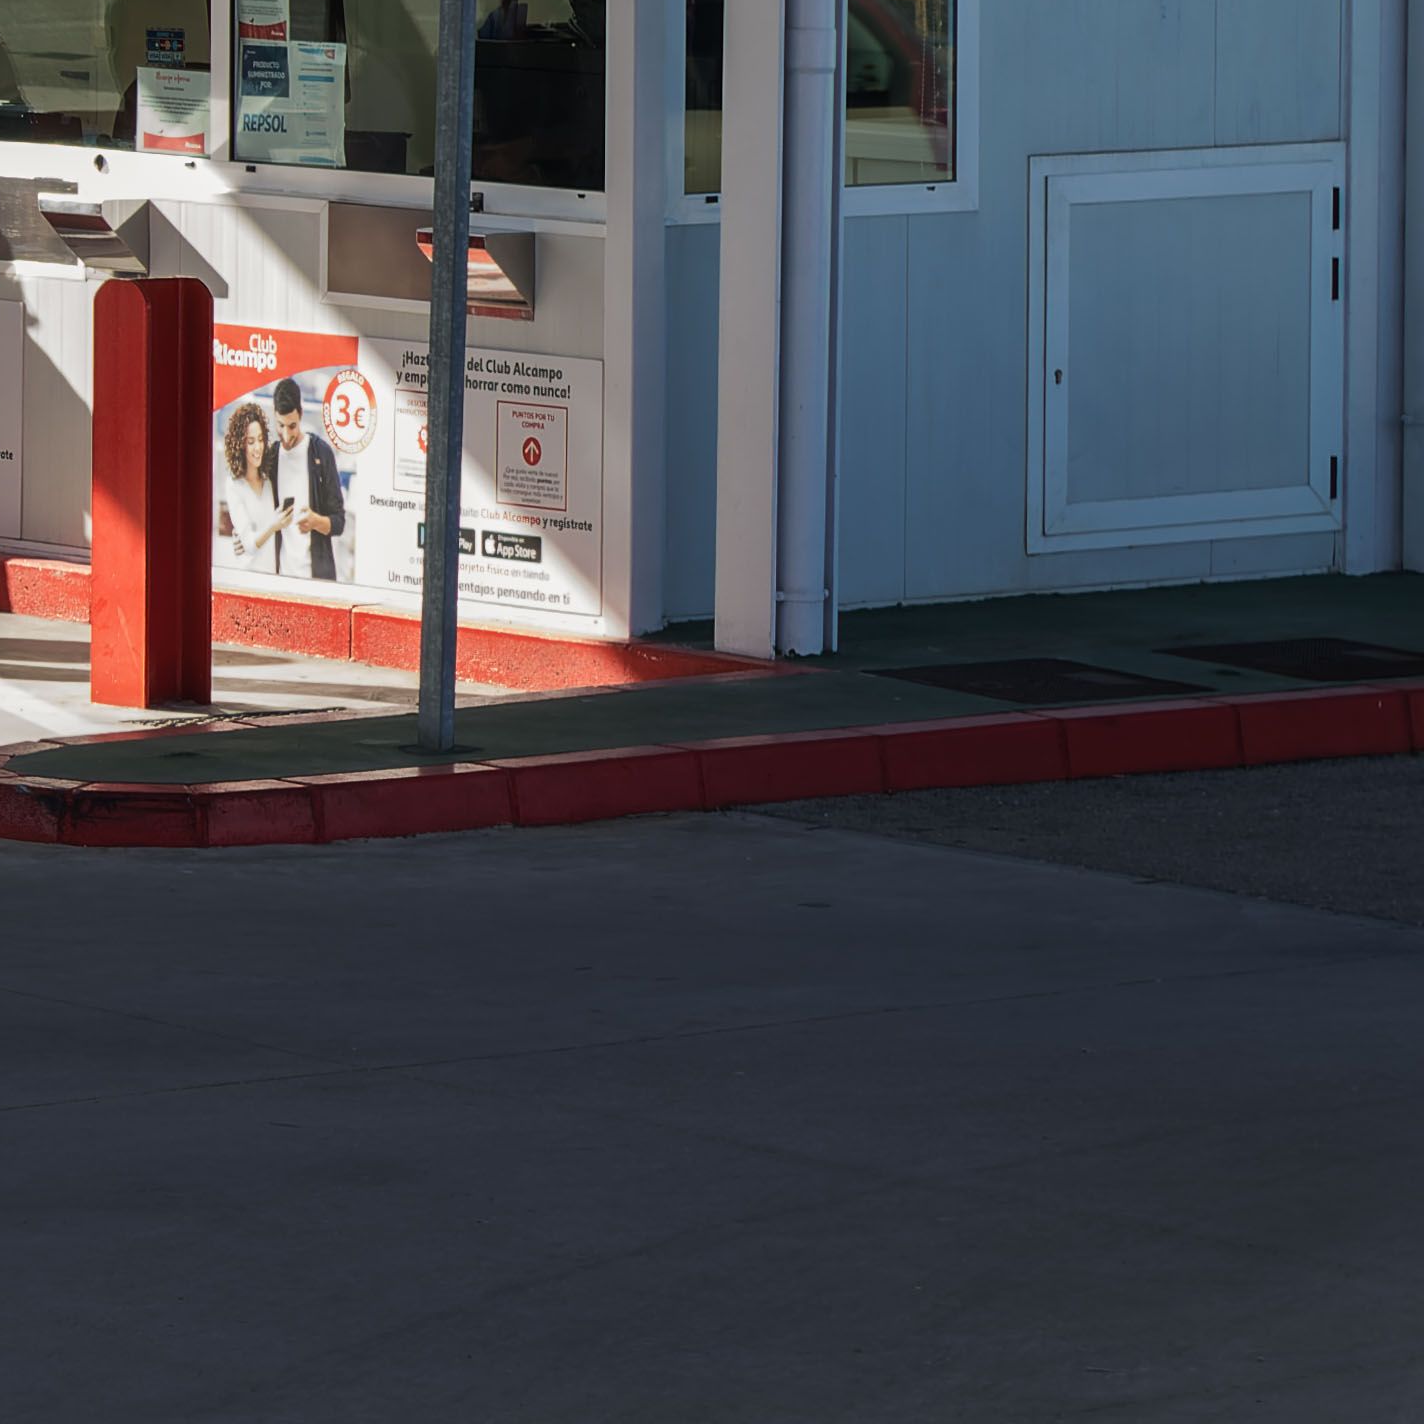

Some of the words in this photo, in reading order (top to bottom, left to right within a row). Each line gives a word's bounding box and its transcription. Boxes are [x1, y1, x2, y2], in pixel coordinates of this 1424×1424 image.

[243, 113, 287, 134] REPSOL
[249, 334, 277, 355] Club
[213, 338, 277, 374] Alcampo
[402, 350, 430, 368] ¡Hazt
[466, 356, 484, 373] del
[485, 359, 511, 376] Club
[512, 362, 563, 384] Alcampo
[396, 370, 402, 385] y
[465, 374, 499, 393] horrar
[501, 381, 531, 396] como
[533, 384, 571, 400] nunca!
[512, 410, 534, 420] PUNTOS
[535, 413, 546, 421] POR
[547, 414, 555, 422] TU
[521, 421, 545, 430] COMPRA
[480, 508, 501, 521] Club
[502, 511, 541, 528] Alcampo
[542, 515, 549, 528] y
[497, 542, 514, 558] App
[514, 543, 537, 560] Store
[459, 562, 486, 575] arjeta
[510, 569, 522, 578] en
[522, 568, 550, 582] tienda
[388, 570, 401, 583] Un
[458, 581, 495, 597] entajas
[496, 584, 546, 603] pensando
[548, 591, 560, 603] en
[562, 590, 571, 605] ti
